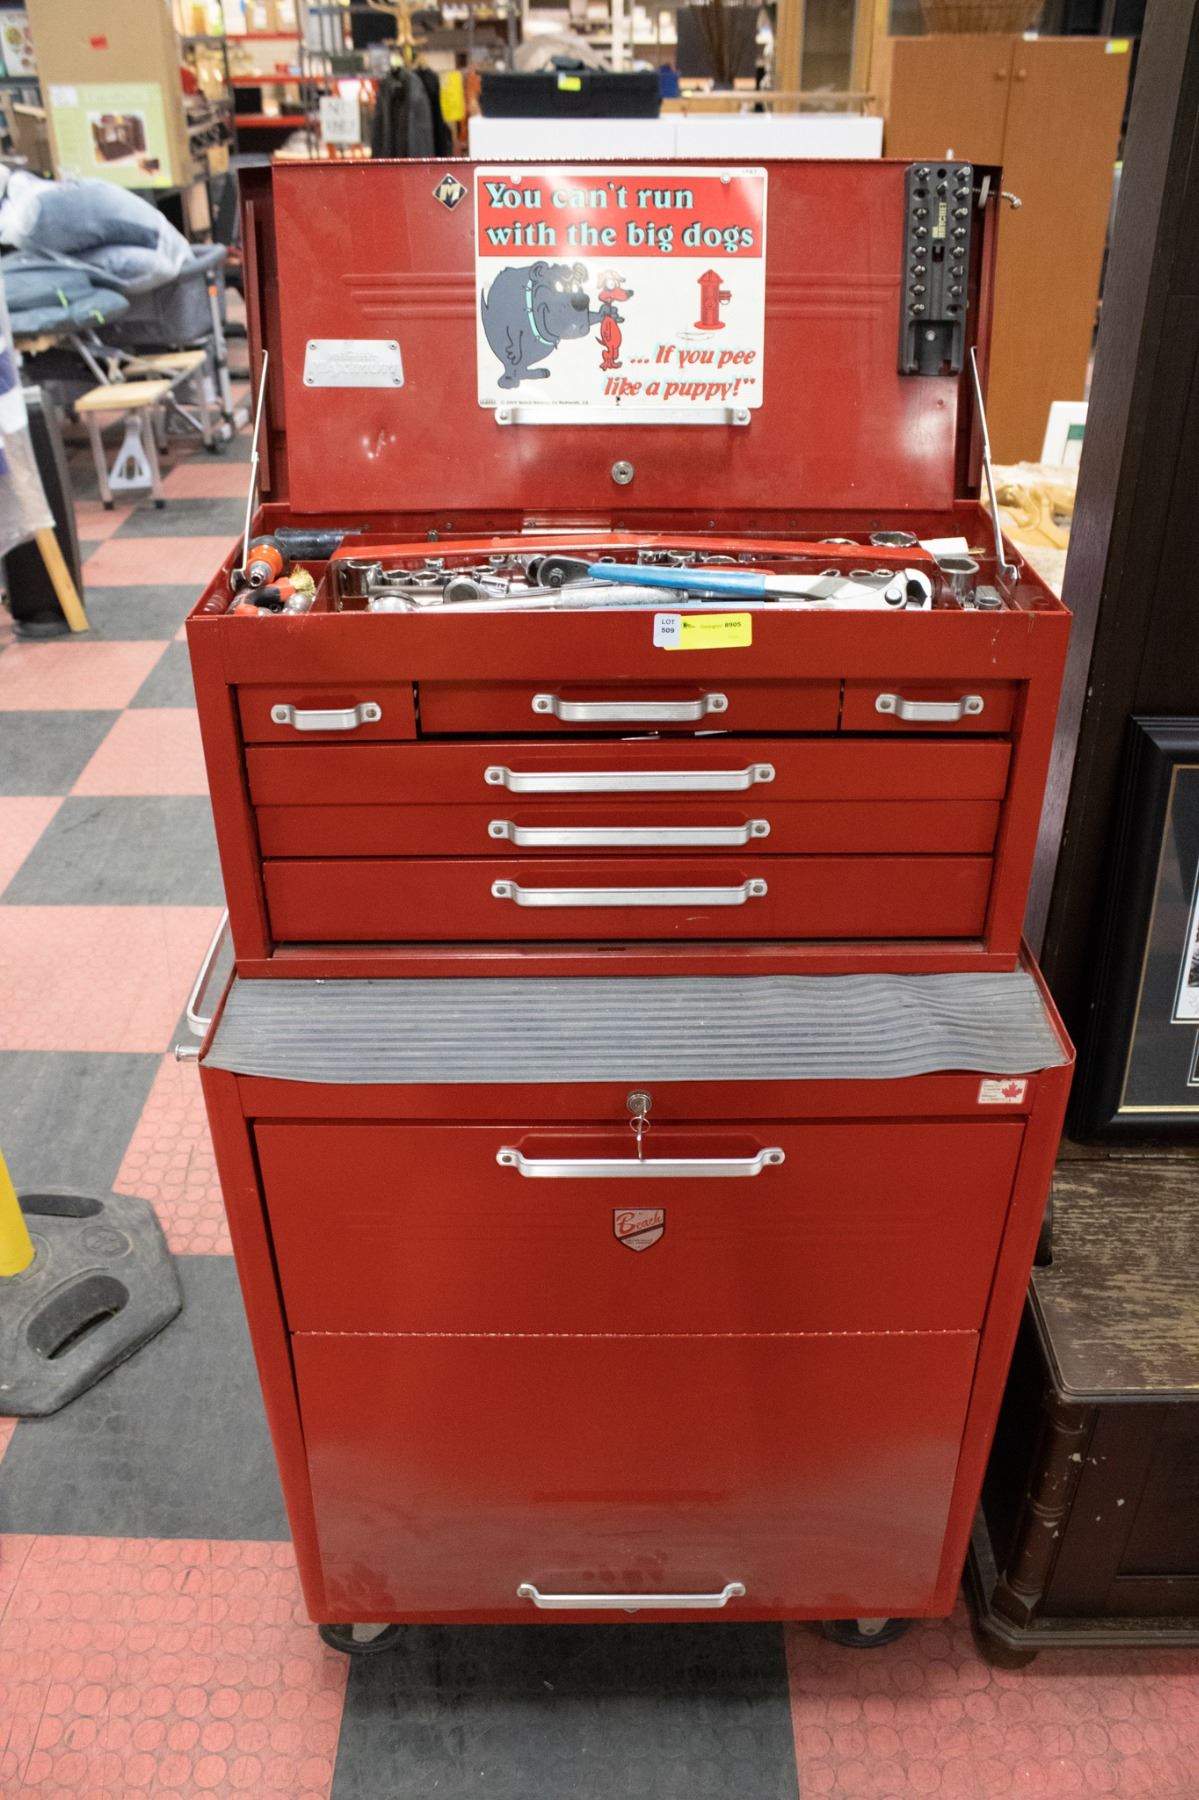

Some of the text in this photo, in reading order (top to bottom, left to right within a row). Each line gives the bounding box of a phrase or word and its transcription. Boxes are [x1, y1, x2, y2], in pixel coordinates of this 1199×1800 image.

[484, 182, 542, 208] You
[636, 188, 694, 208] run
[486, 221, 754, 253] with the big dogs
[677, 350, 714, 369] you
[717, 350, 756, 372] pee
[603, 377, 642, 396] like
[645, 382, 660, 396] a
